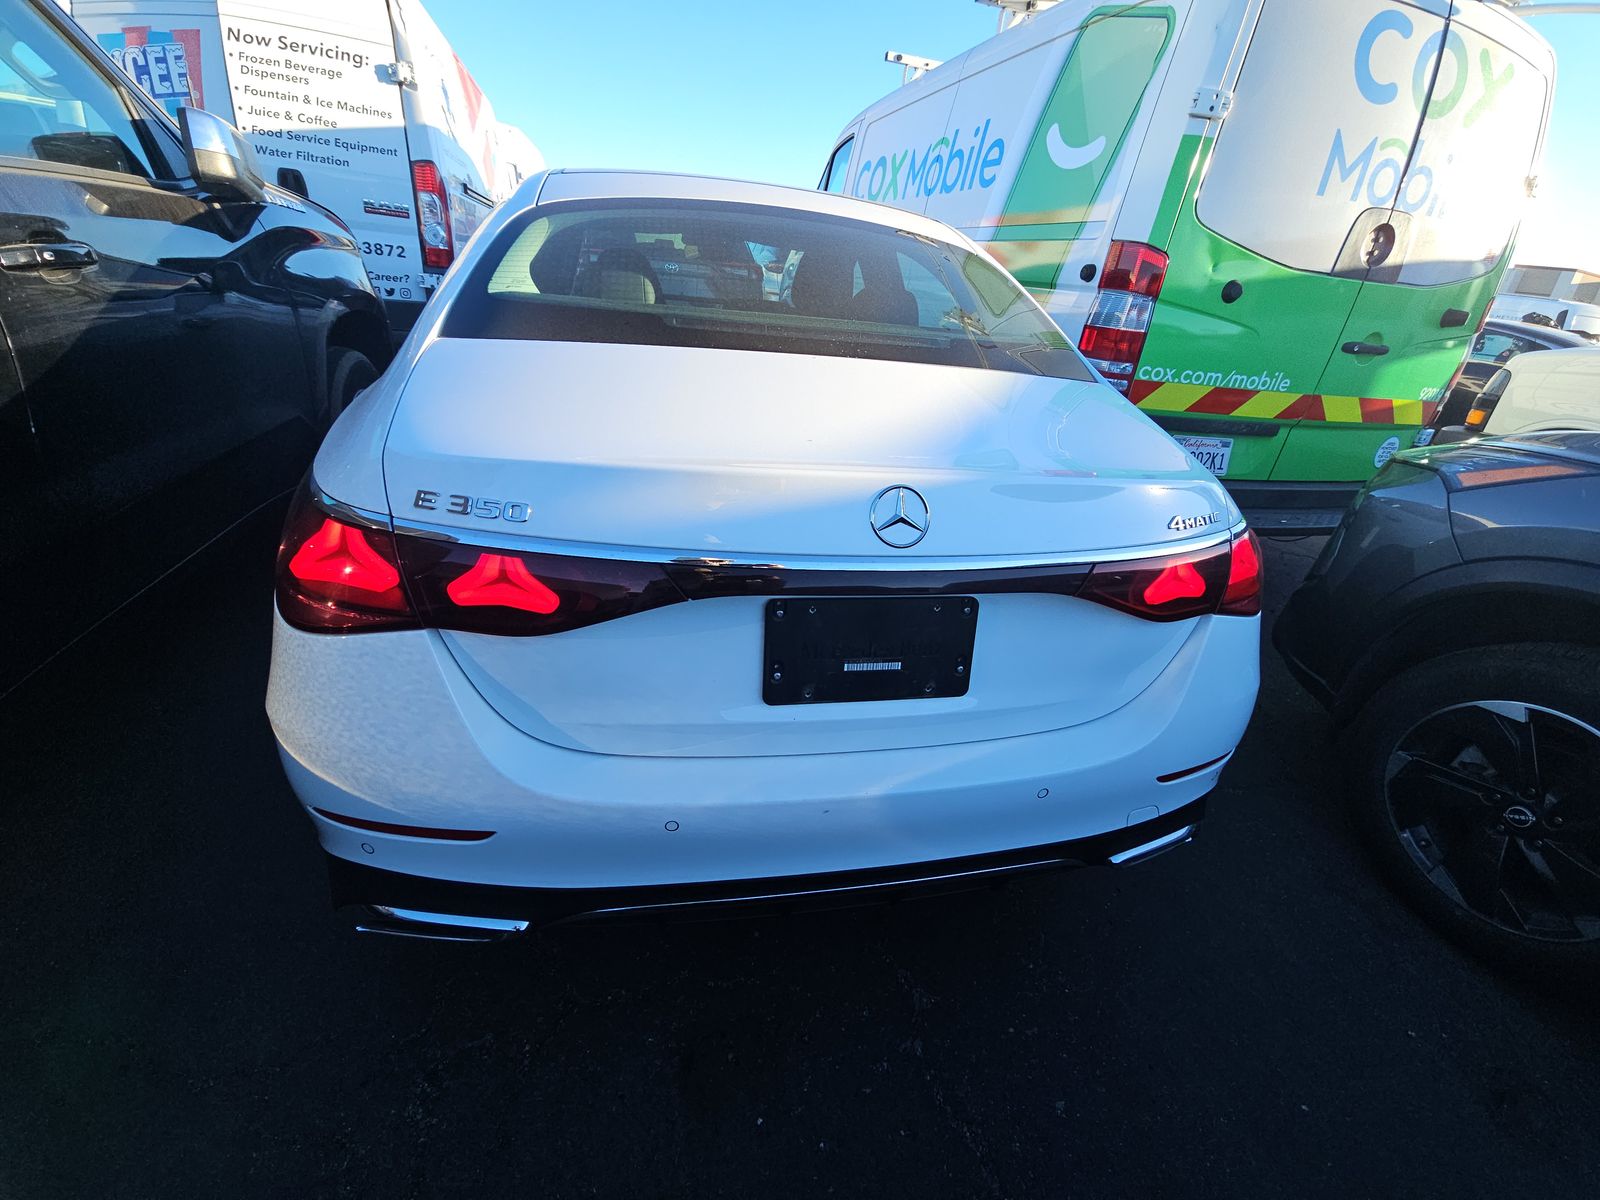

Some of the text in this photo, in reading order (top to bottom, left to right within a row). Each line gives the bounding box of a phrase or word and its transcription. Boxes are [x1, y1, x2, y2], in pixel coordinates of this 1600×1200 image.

[227, 27, 369, 68] Now Servicing:
[110, 43, 190, 98] CEE
[238, 51, 343, 79] Frozen Beverage
[240, 65, 310, 85] Dispensers
[244, 85, 393, 120] Fountain & Ice Machines
[247, 105, 338, 129] Juice & Coffee
[251, 125, 399, 157] Food Service Equipment
[254, 144, 350, 168] Water Filtration
[367, 270, 410, 283] Career?
[1138, 365, 1291, 392] cox.com/mobile
[1183, 438, 1222, 450] California
[1190, 450, 1225, 470] 02K1
[413, 489, 532, 523] E 350
[1168, 512, 1221, 531] 4MATIC
